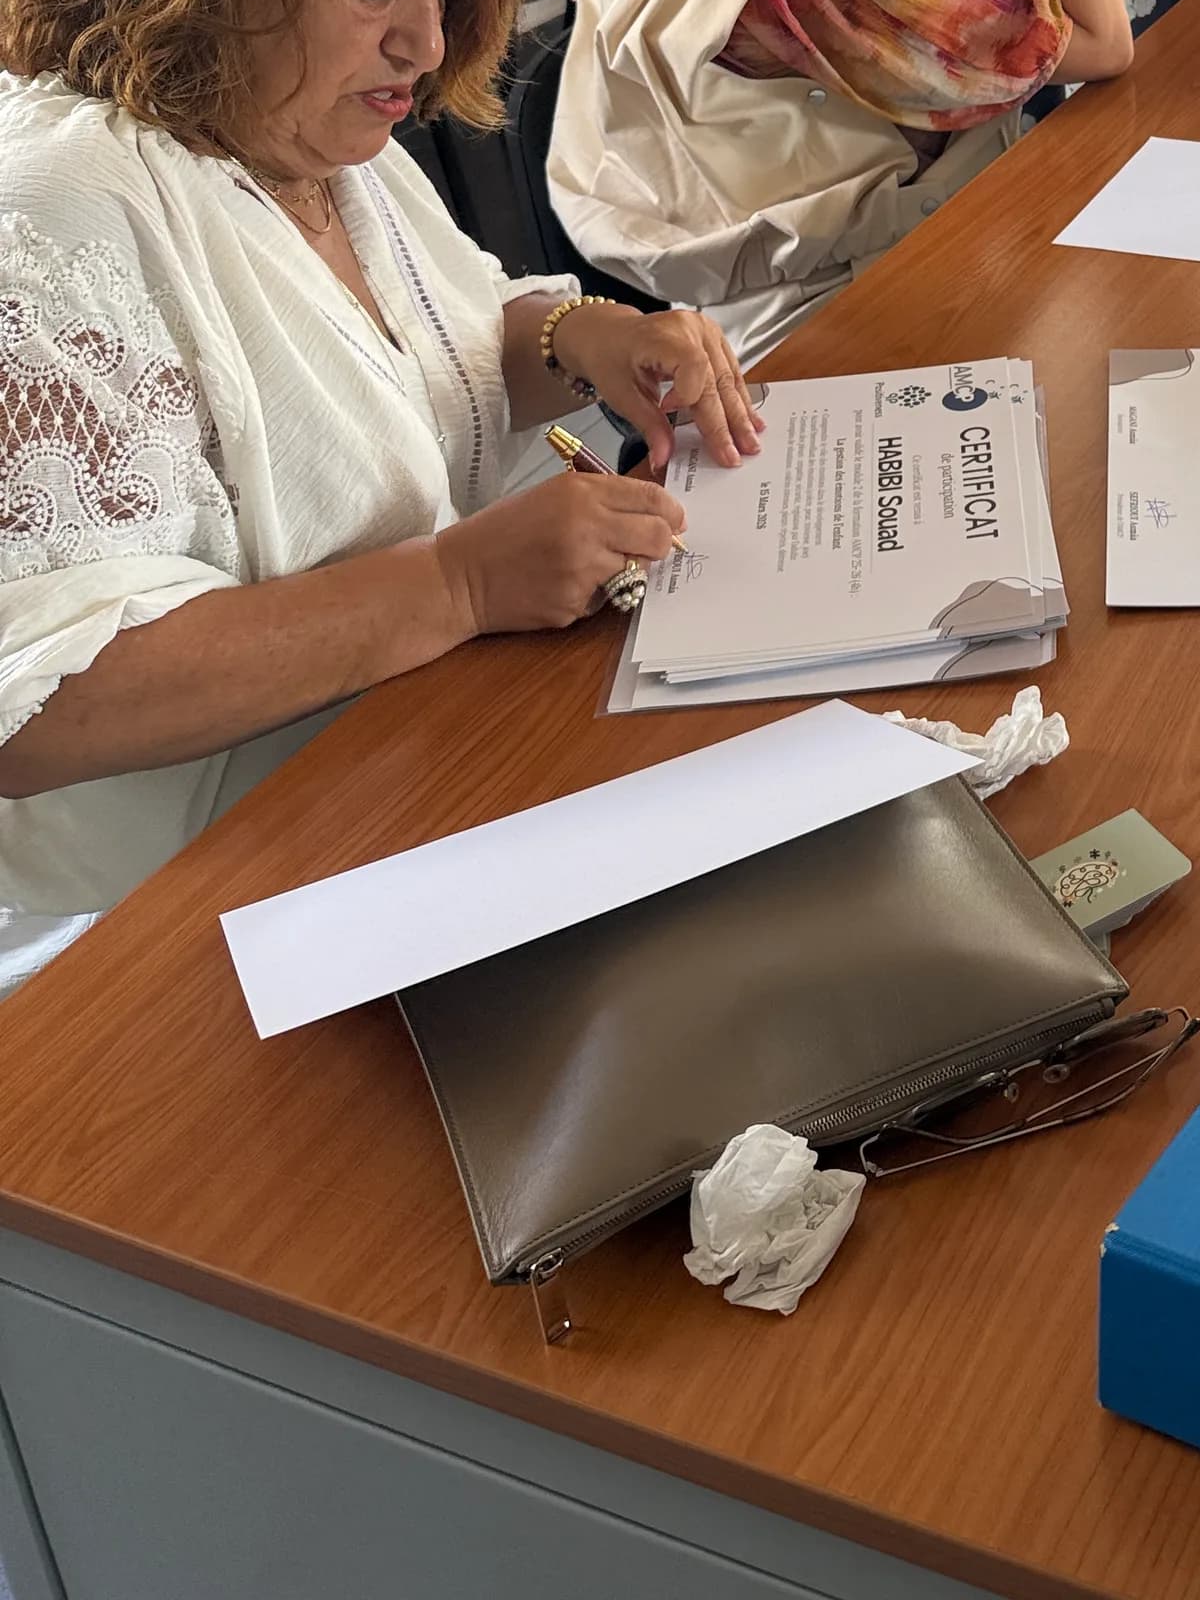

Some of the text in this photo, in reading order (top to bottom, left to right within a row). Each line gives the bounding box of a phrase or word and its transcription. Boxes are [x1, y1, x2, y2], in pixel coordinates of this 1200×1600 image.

[953, 366, 975, 402] AMCP
[877, 437, 905, 552] HABIBI Souad
[937, 453, 956, 519] de participation
[960, 426, 999, 540] CERTIFICAT
